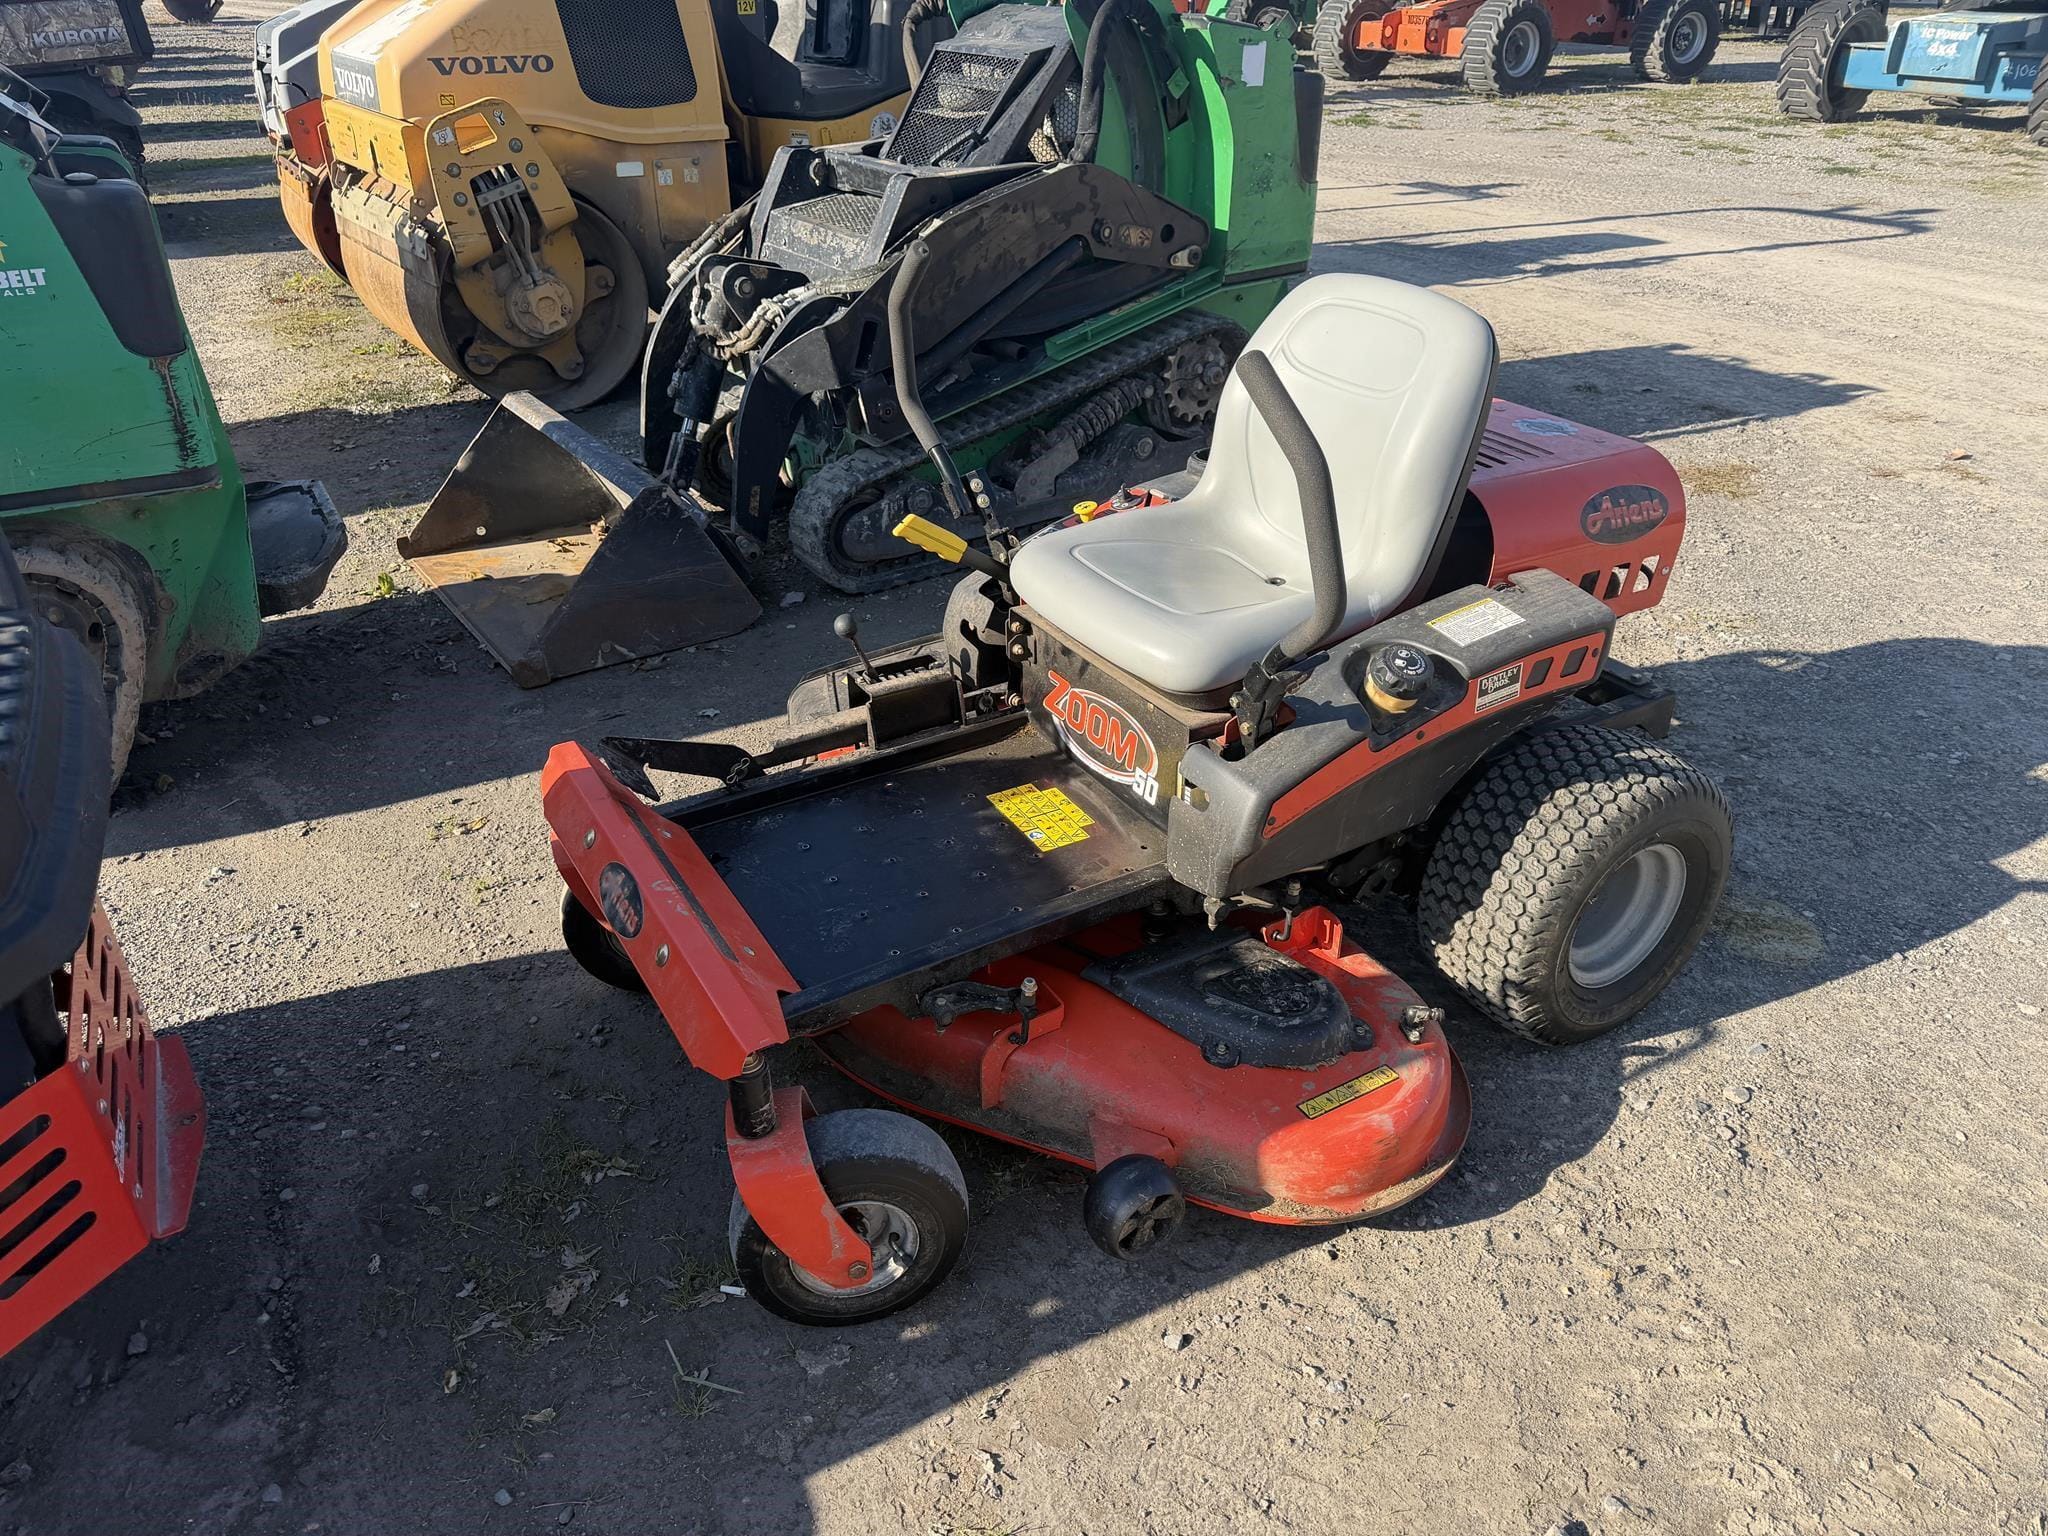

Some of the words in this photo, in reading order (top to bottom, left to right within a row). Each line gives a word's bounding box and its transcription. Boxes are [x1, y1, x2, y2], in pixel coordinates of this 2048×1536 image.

[739, 0, 754, 12] 12V
[32, 27, 121, 48] KUBOTA
[1927, 41, 1958, 56] 4x4
[427, 54, 554, 76] VOLVO
[334, 66, 375, 99] VOLVO
[1586, 495, 1663, 535] Ariens
[1482, 666, 1519, 690] BENTLEY
[1043, 670, 1138, 771] ZOOM
[1132, 766, 1159, 806] 50
